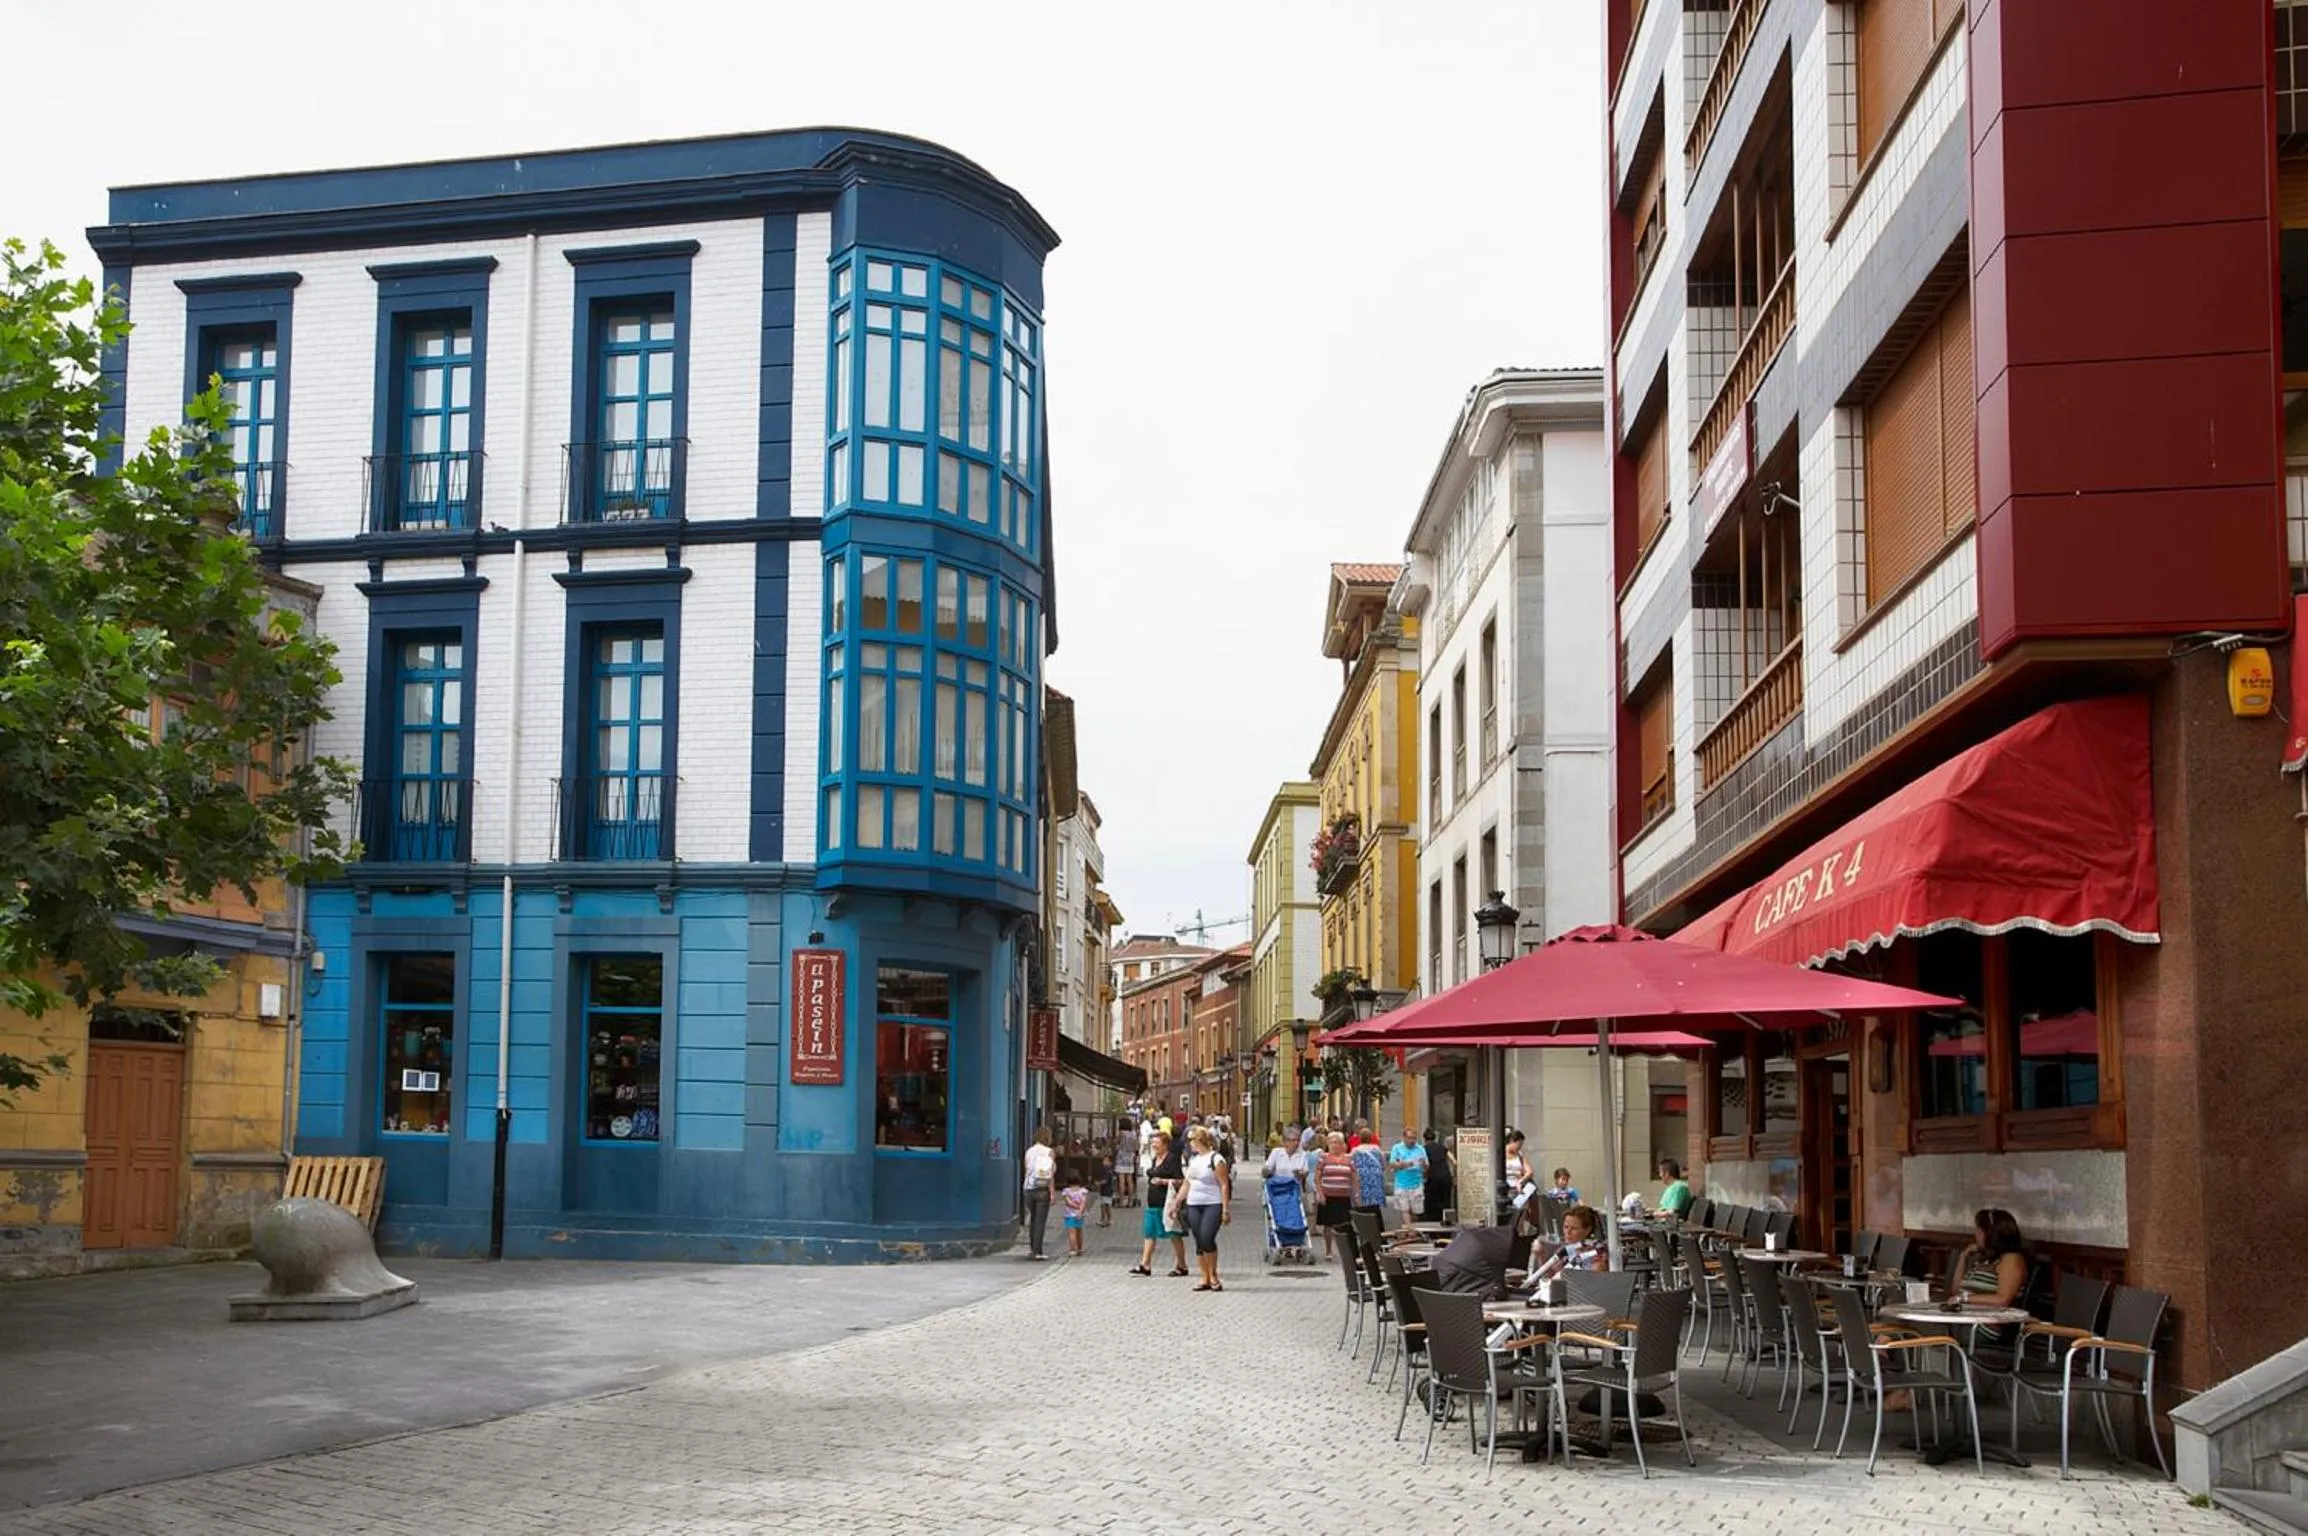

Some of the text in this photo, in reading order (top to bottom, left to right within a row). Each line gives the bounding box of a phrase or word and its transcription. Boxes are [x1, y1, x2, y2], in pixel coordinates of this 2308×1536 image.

[1754, 840, 1866, 934] CAFE K 4
